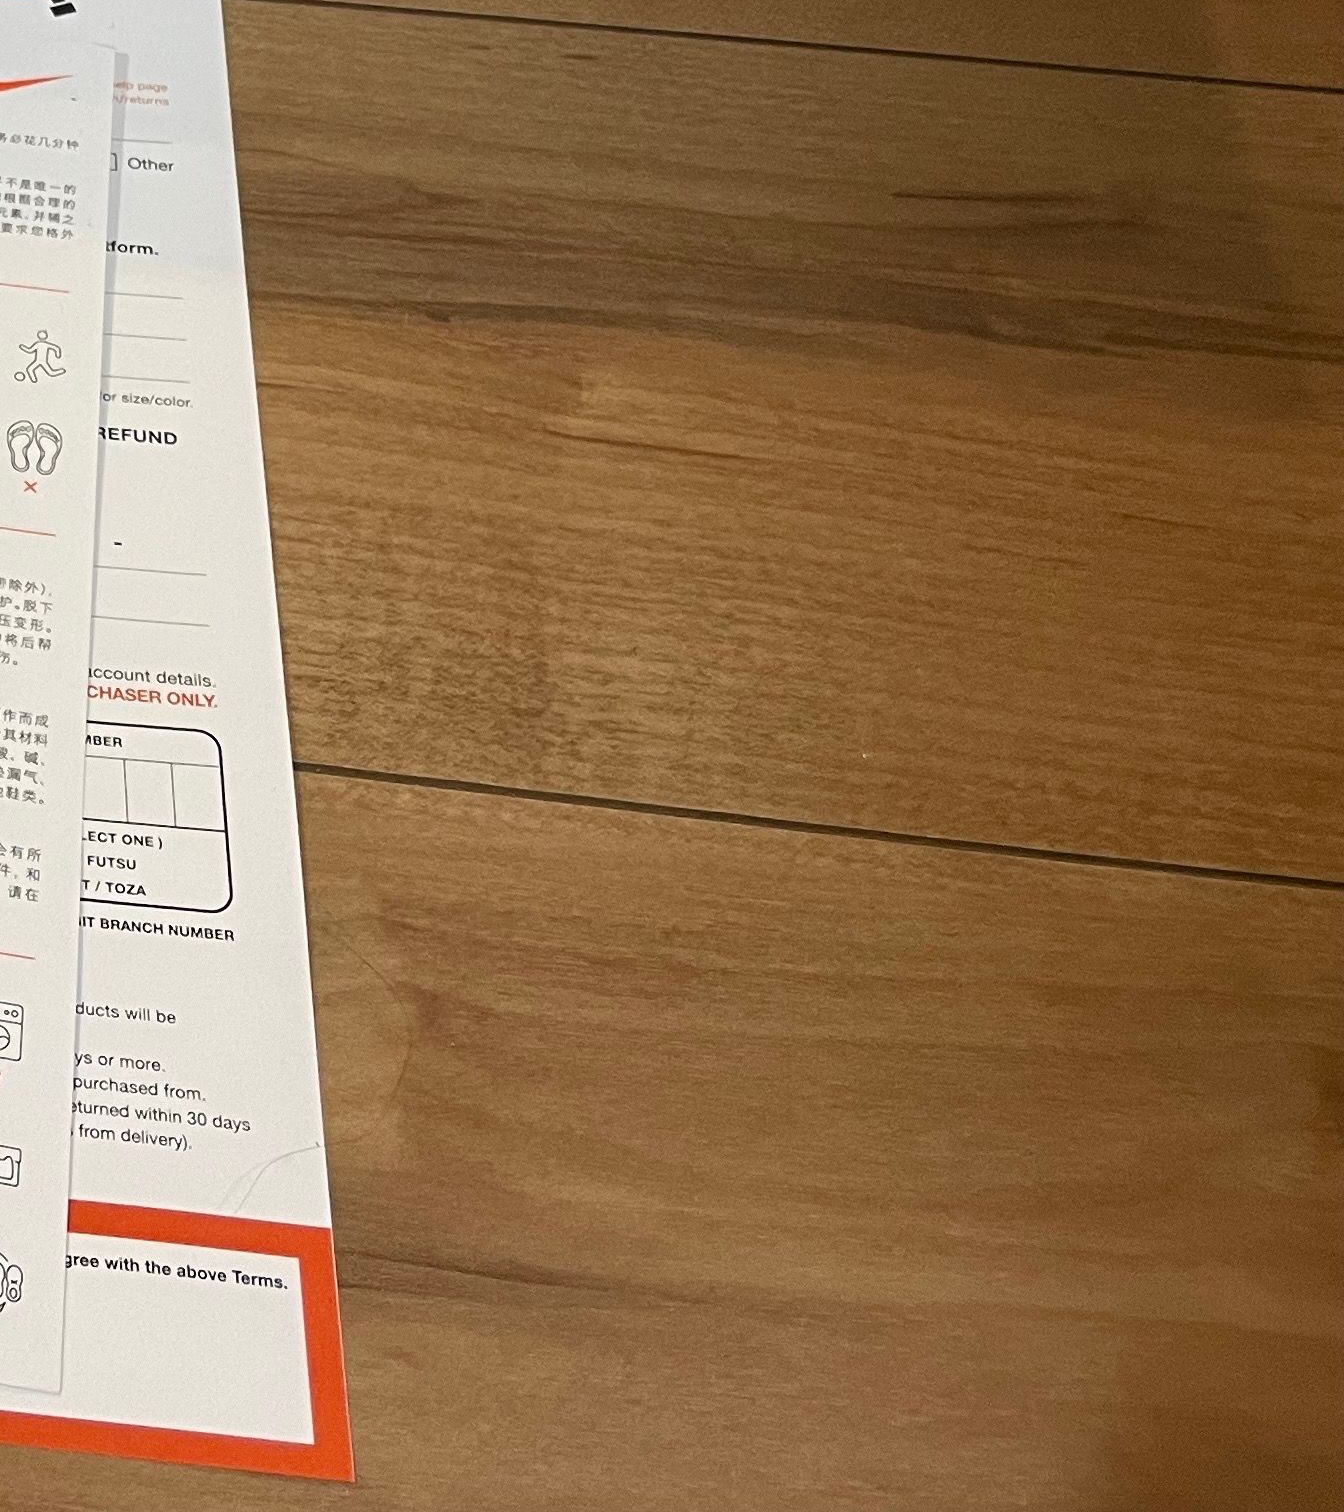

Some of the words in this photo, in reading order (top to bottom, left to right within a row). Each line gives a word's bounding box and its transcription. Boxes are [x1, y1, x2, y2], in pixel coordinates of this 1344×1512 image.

[128, 158, 173, 171] Other
[122, 393, 193, 408] size/color.
[157, 671, 216, 688] details.
[167, 692, 217, 707] ONLY.
[122, 834, 153, 847] ONE
[88, 856, 136, 869] FUTSU
[100, 918, 163, 934] BRANCH
[169, 925, 234, 941] NUMBER
[125, 1008, 150, 1021] will
[156, 1010, 176, 1023] be
[75, 1053, 92, 1067] ys
[98, 1056, 113, 1065] or
[120, 1058, 166, 1072] more.
[73, 1077, 158, 1095] purchased
[164, 1084, 205, 1101] from.
[135, 1108, 181, 1123] within
[187, 1112, 206, 1126] 30
[213, 1115, 250, 1133] days
[79, 1124, 115, 1140] from
[121, 1129, 192, 1151] delivery).
[105, 1258, 139, 1272] with
[145, 1261, 171, 1275] the
[177, 1265, 226, 1282] above
[232, 1270, 287, 1289] Terms.
